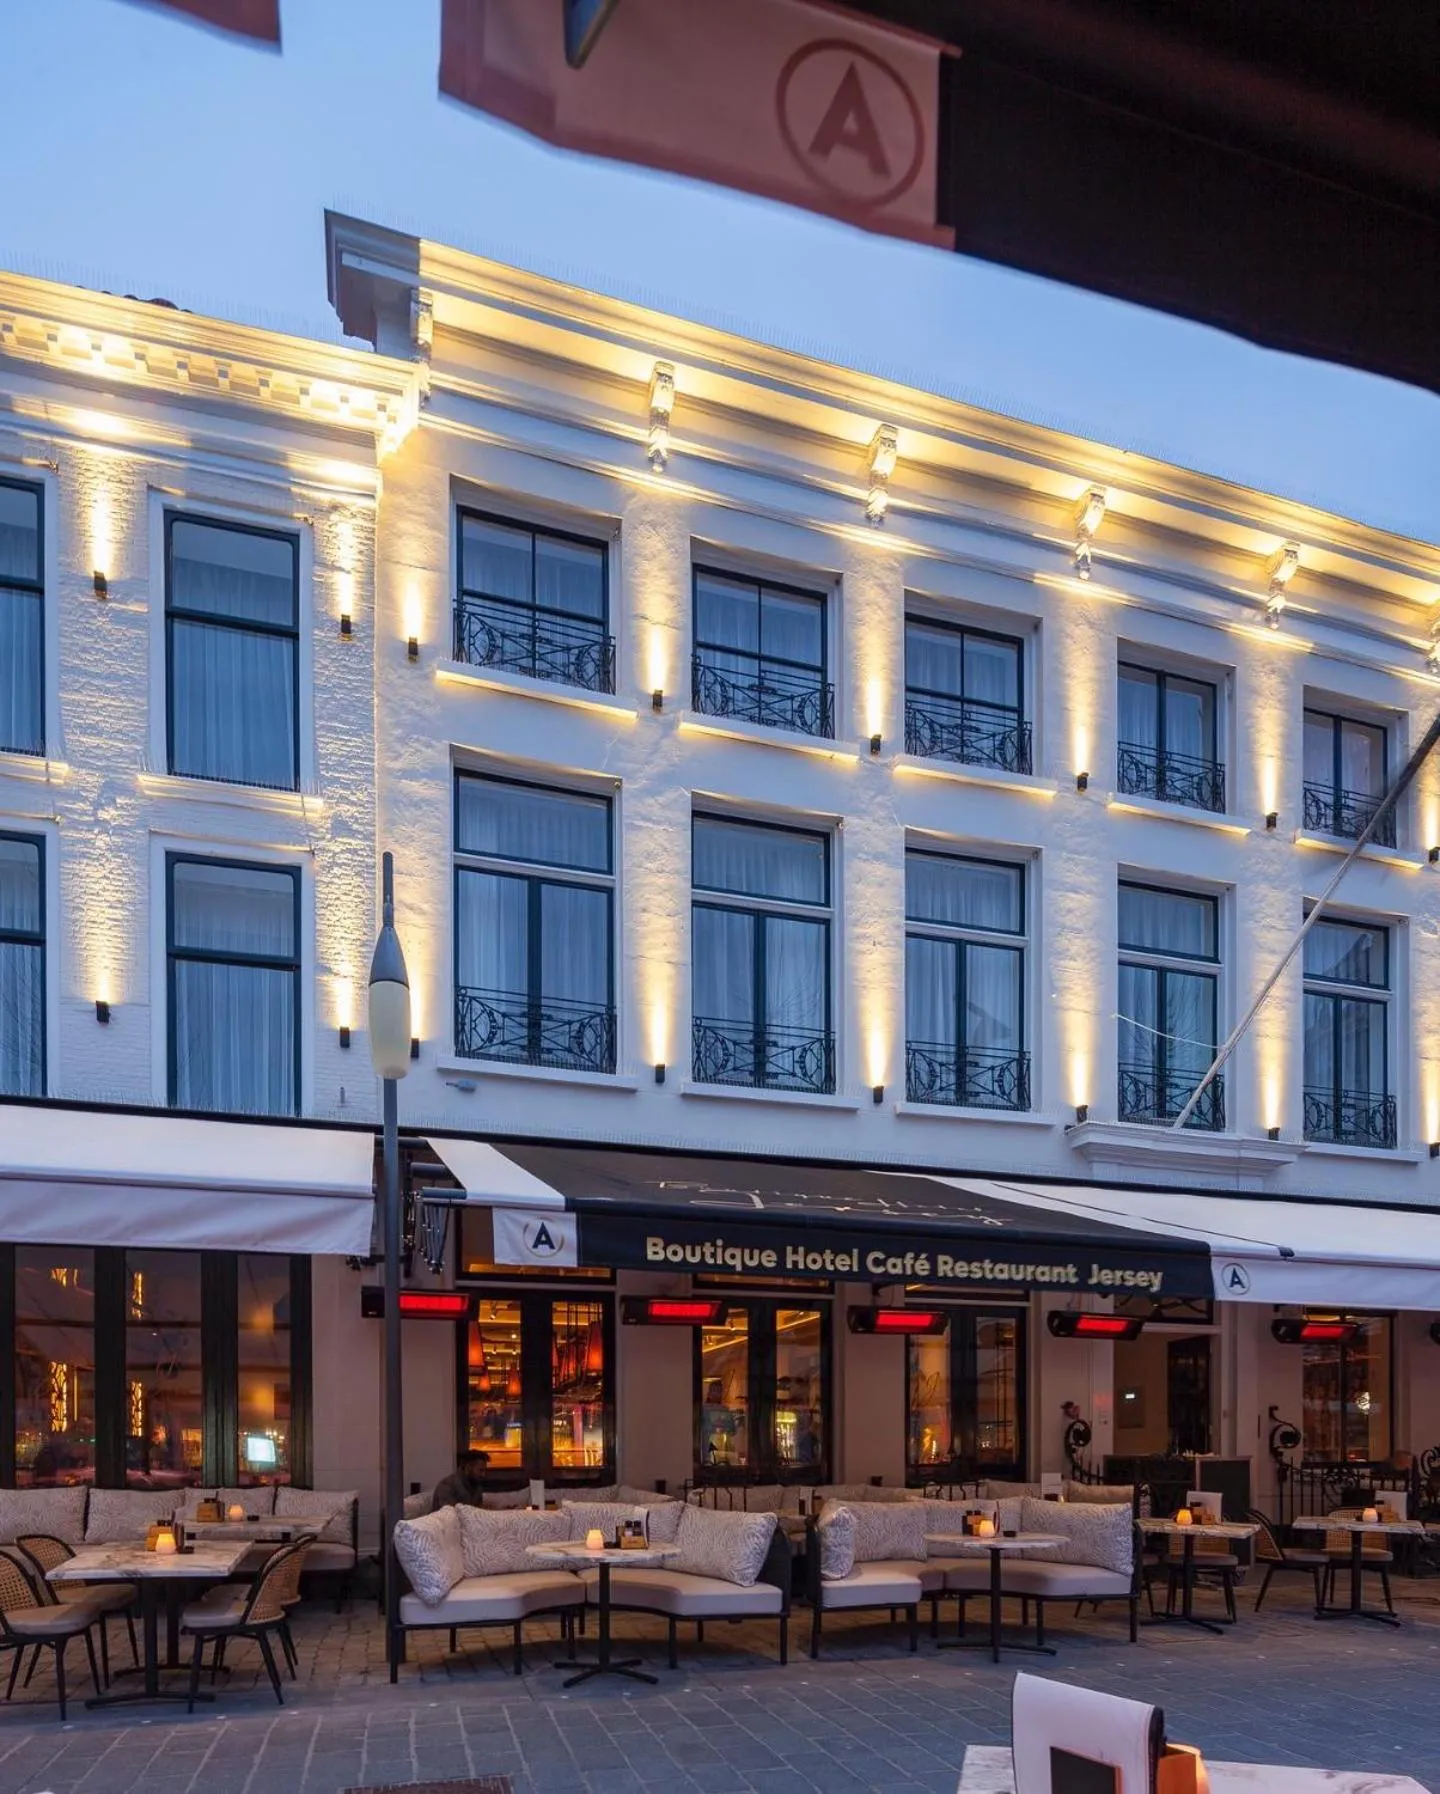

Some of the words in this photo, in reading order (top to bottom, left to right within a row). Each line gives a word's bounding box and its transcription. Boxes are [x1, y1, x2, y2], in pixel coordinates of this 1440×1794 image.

[807, 60, 892, 180] A
[532, 1221, 555, 1249] A
[645, 1235, 777, 1271] Boutique
[785, 1246, 859, 1273] Hotel
[866, 1249, 930, 1275] Café
[937, 1255, 1077, 1283] Restaurant
[1087, 1263, 1163, 1292] Jersey
